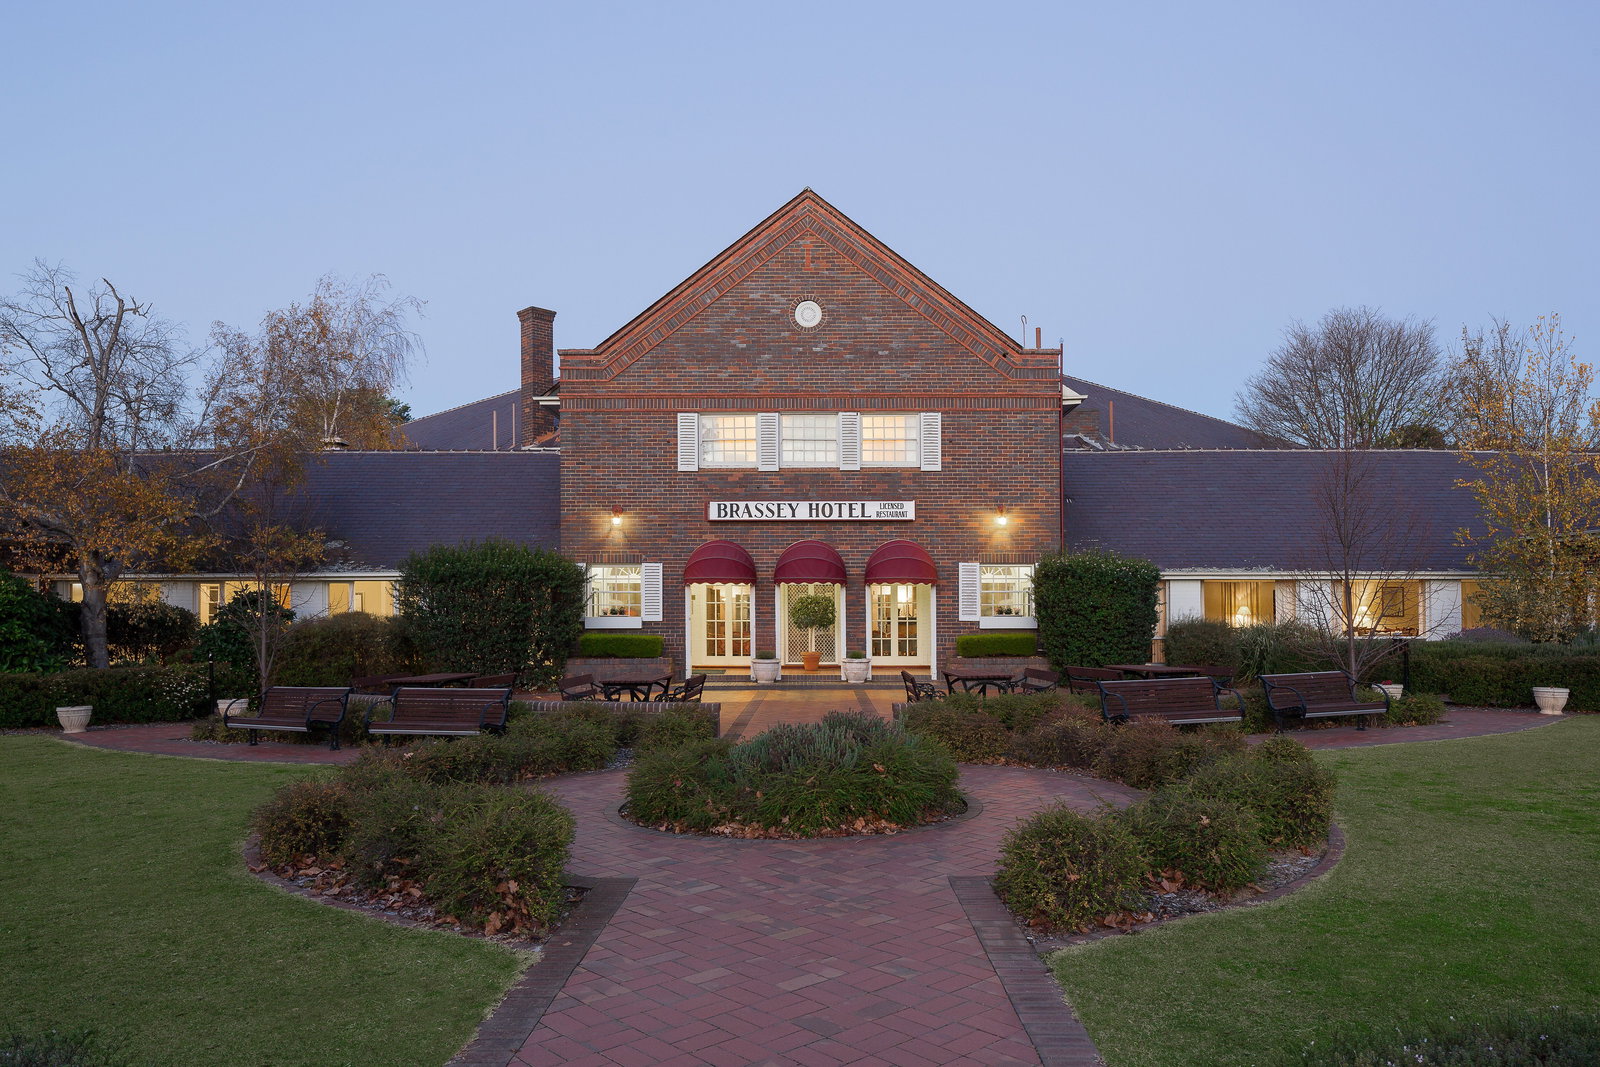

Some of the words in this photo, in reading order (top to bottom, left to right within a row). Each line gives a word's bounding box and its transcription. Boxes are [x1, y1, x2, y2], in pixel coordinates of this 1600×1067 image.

[879, 502, 904, 510] LICENSED
[717, 503, 799, 518] BRASSEY
[808, 503, 871, 518] HOTEL
[876, 510, 908, 518] RESTAURANT
